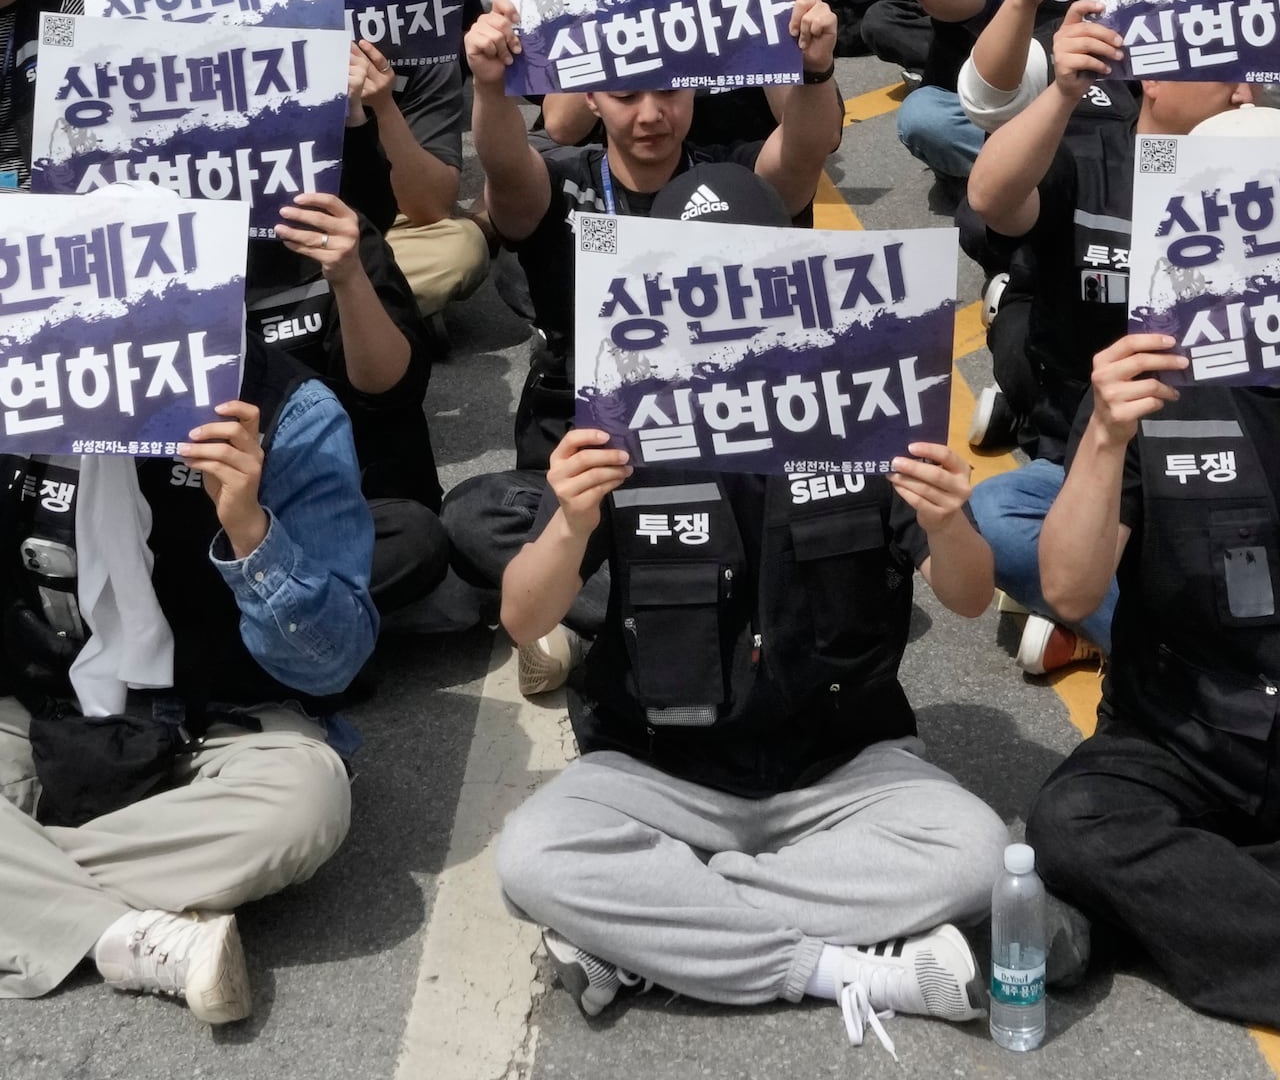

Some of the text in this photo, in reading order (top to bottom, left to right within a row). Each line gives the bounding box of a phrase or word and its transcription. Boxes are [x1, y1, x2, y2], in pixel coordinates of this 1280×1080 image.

[55, 40, 309, 129] 상한폐지
[671, 72, 800, 87] 삼성전자노동조합 공동투쟁본부
[680, 199, 730, 220] adidas
[597, 242, 909, 353] 상한폐지
[263, 313, 322, 344] SELU
[627, 356, 951, 464] 실현하자
[72, 439, 161, 455] 삼성전자노동조합
[783, 459, 877, 475] 삼성전자노동조합
[1165, 452, 1237, 483] 투쟁
[635, 512, 710, 545] 투쟁
